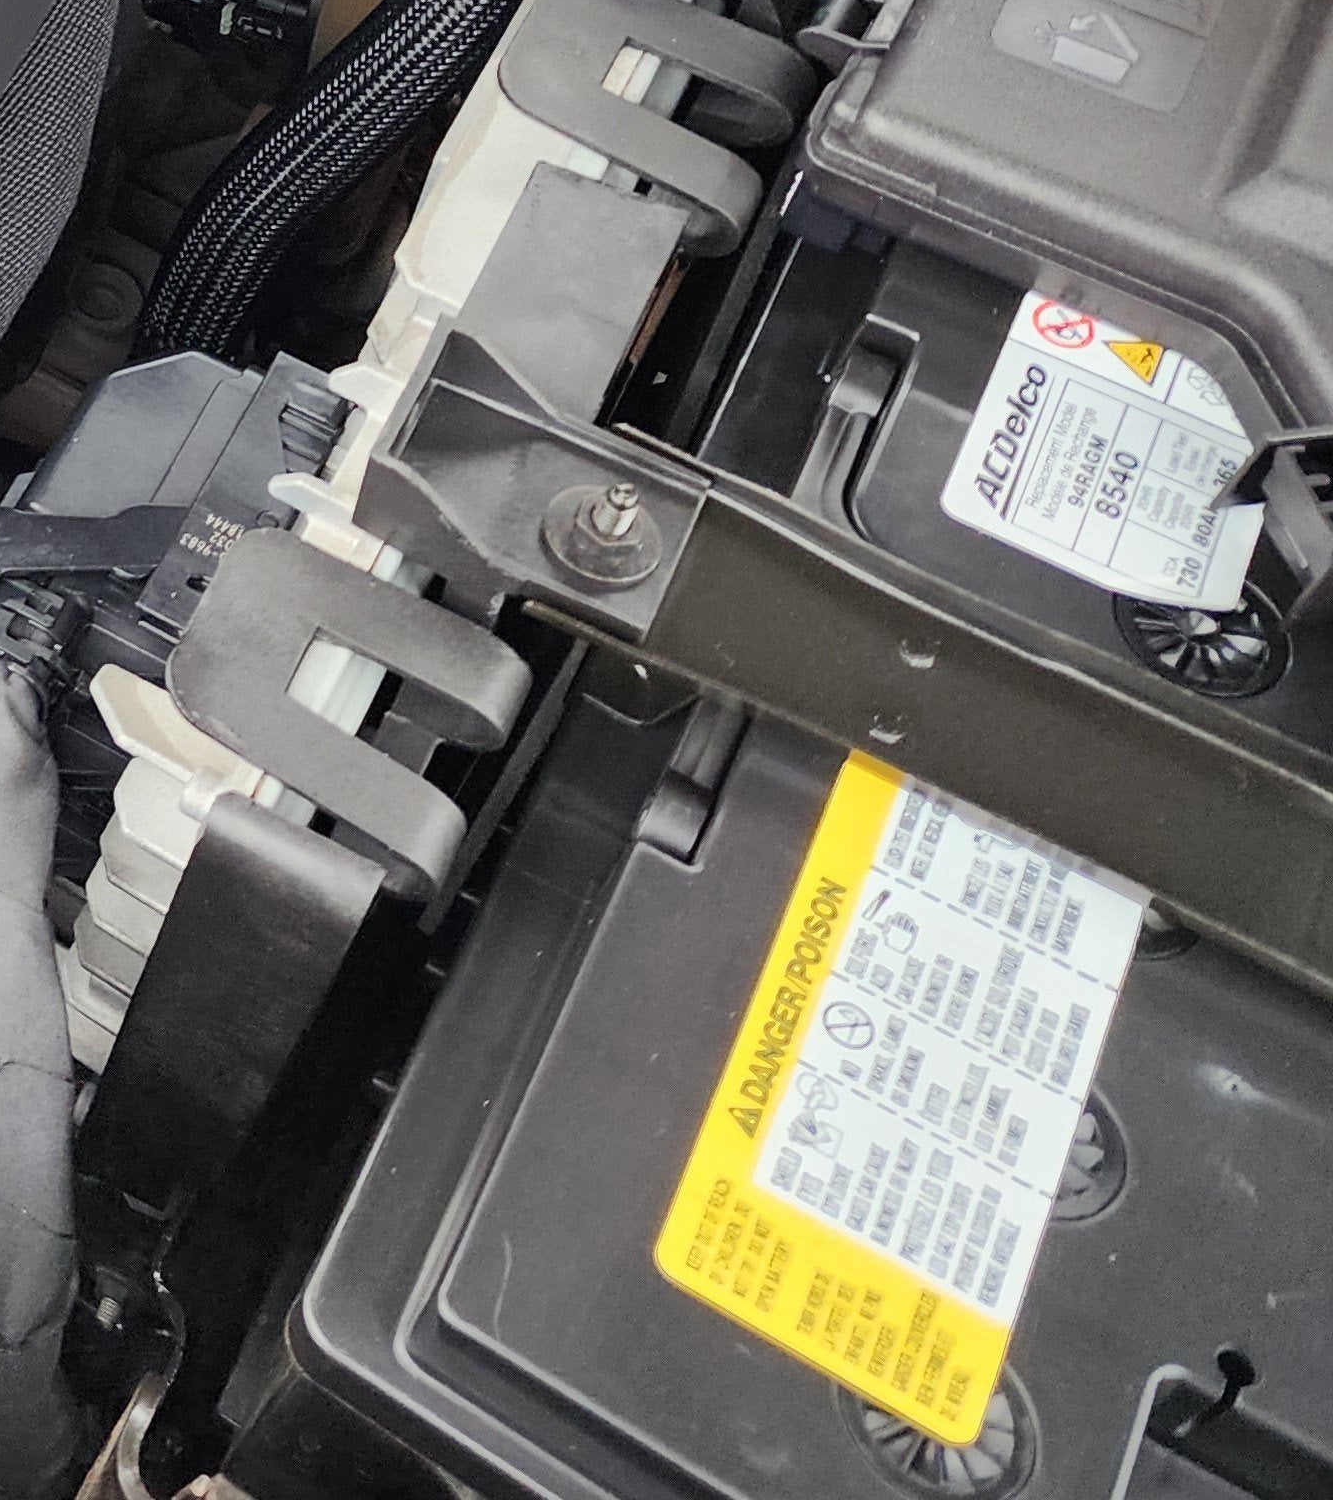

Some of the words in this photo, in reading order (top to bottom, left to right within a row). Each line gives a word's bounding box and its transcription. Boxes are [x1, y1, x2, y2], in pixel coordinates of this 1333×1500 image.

[974, 361, 1047, 510] ACDelco
[1025, 435, 1064, 509] Replacement
[1054, 400, 1078, 438] Model
[1062, 405, 1100, 463] Rechange
[1055, 461, 1074, 480] de
[1067, 434, 1108, 509] 94RAGM
[1094, 451, 1142, 520] 8540
[1176, 554, 1201, 591] 730
[738, 875, 849, 1105] DANGER/POISON
